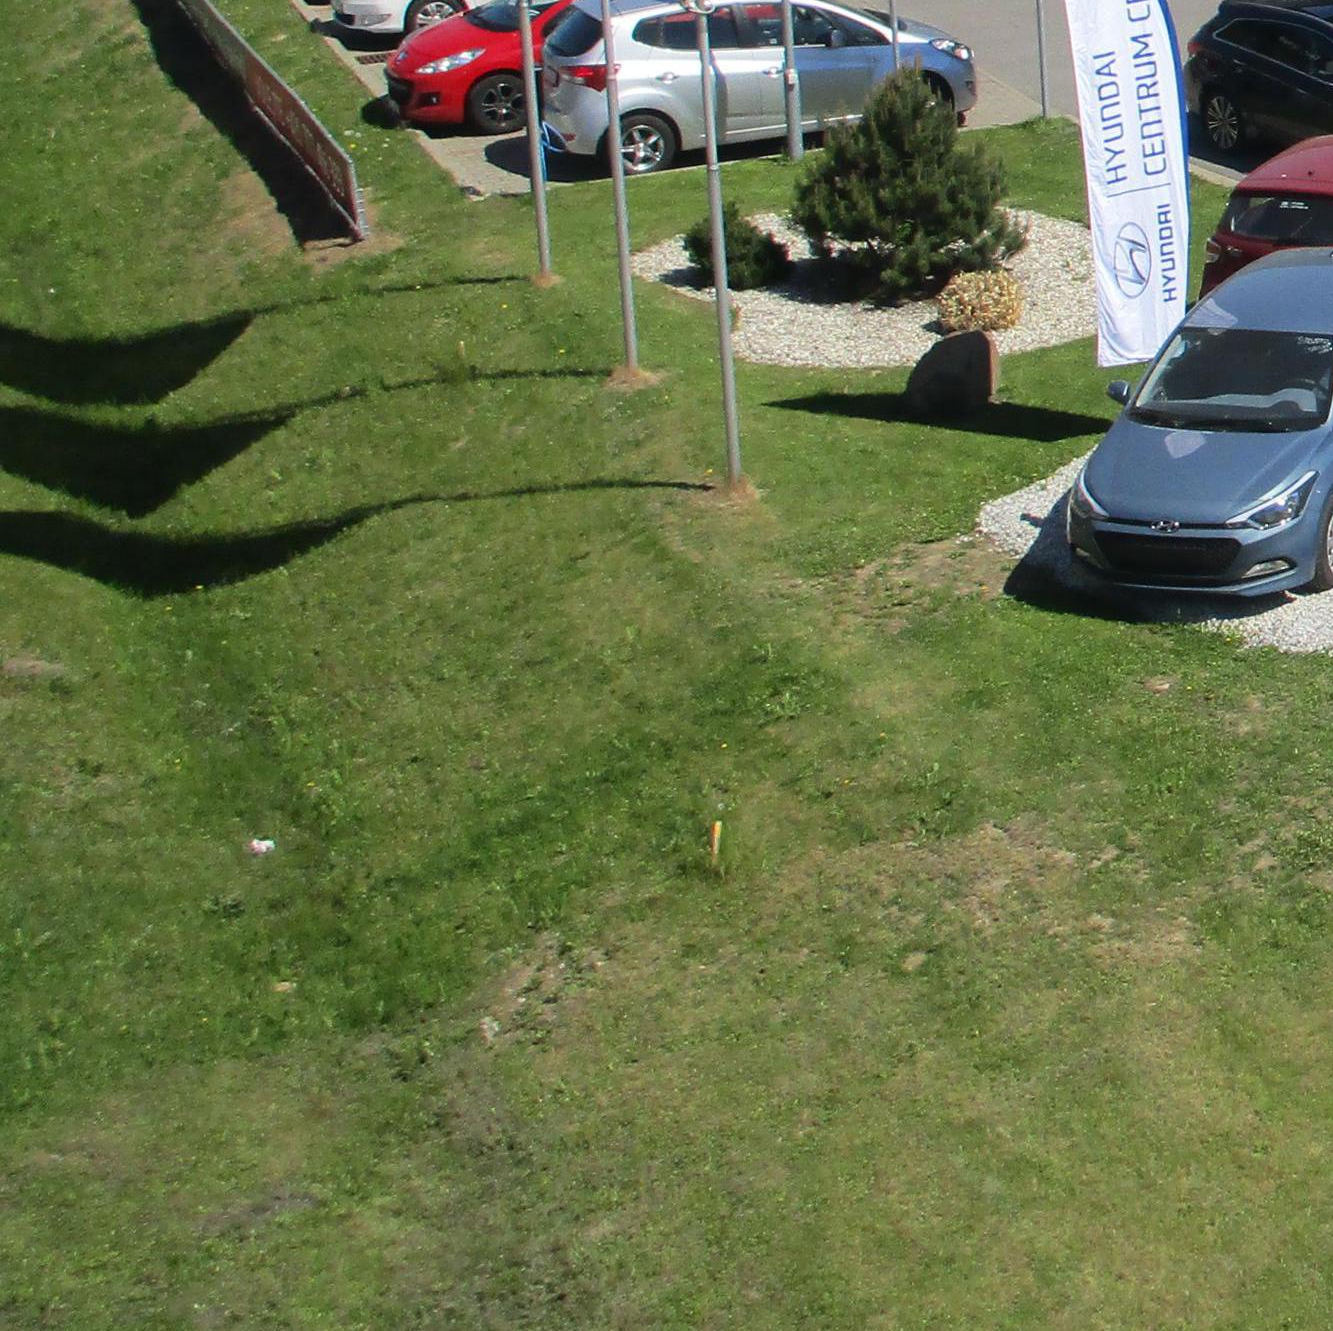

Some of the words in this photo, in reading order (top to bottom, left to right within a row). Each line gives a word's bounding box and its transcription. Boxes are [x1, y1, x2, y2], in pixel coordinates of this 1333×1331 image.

[1092, 50, 1129, 186] HYUNDAI
[1129, 32, 1168, 177] CENTRUM
[1157, 202, 1178, 304] HYUNDAI
